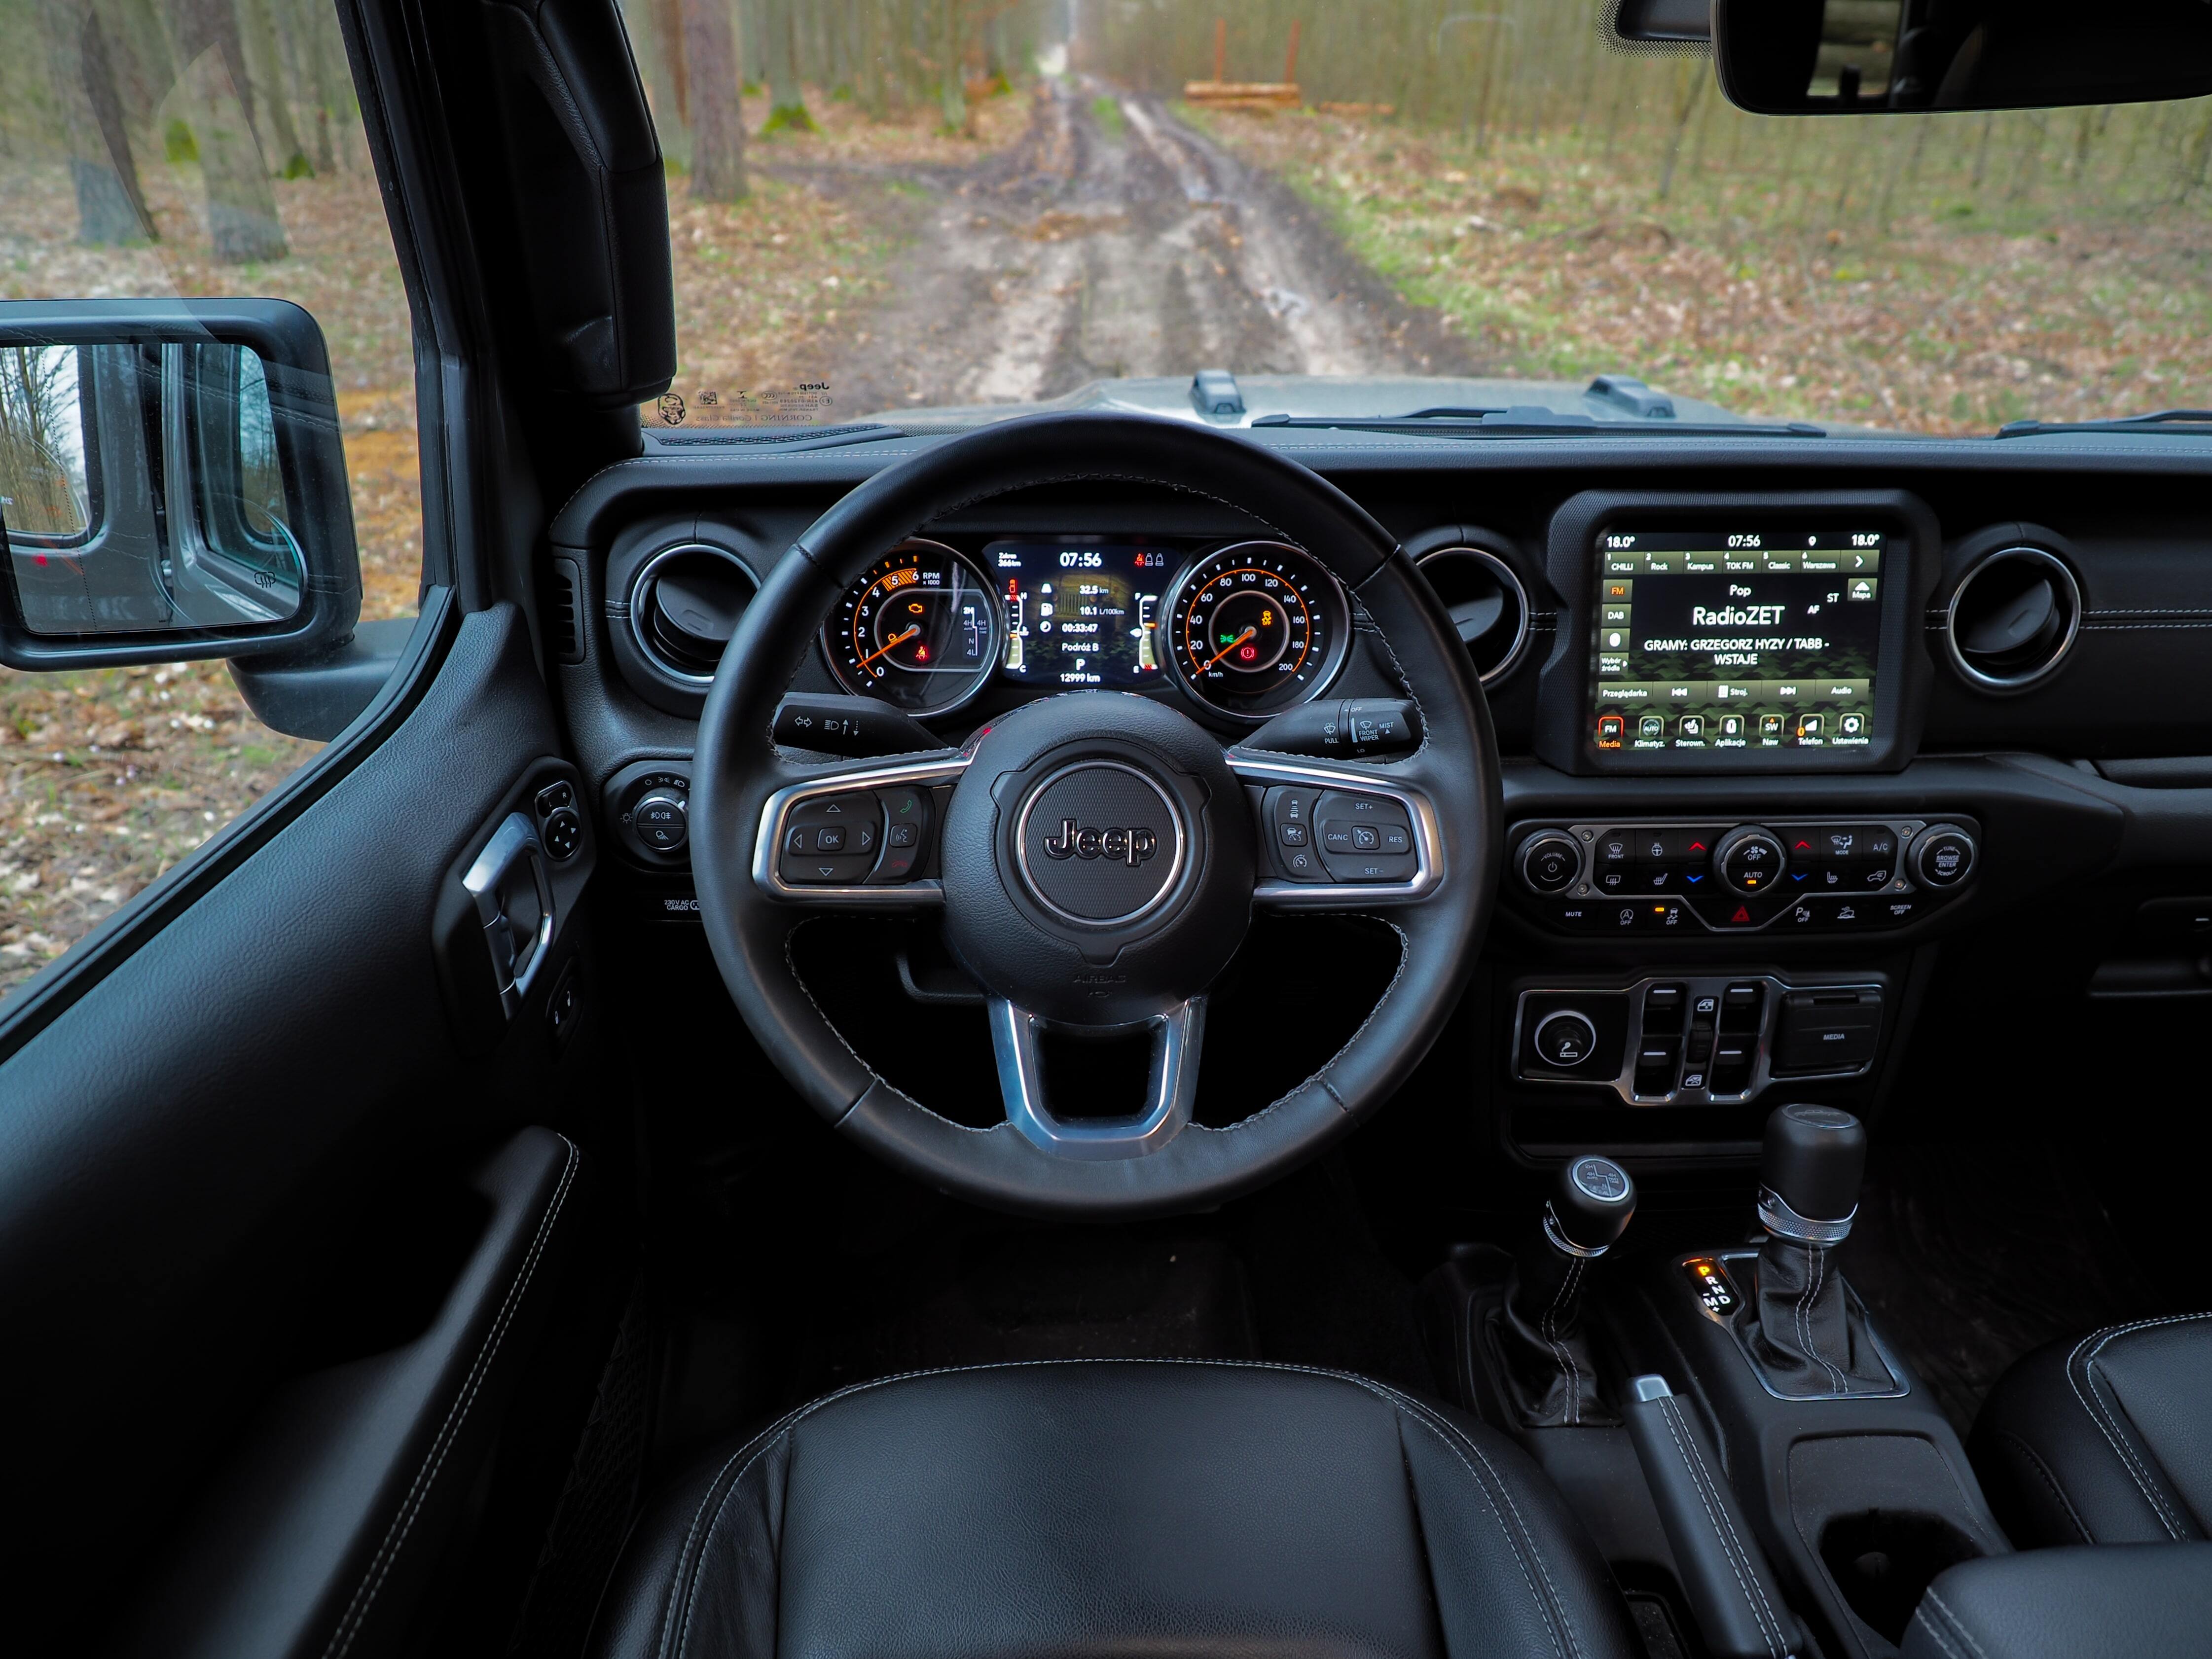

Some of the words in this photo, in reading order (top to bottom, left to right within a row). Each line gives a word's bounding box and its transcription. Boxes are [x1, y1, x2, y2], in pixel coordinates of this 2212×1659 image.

[1728, 535, 1761, 547] 07:56
[1060, 552, 1102, 567] 07:56
[1687, 562, 1714, 571] Kampus
[912, 571, 919, 580] 6
[891, 576, 899, 585] 5
[1220, 578, 1232, 586] 80
[1265, 579, 1278, 587] 120
[872, 588, 880, 598] 4
[1080, 585, 1098, 594] 32.5
[1730, 584, 1751, 597] Pop
[1200, 593, 1213, 602] 60
[1284, 595, 1296, 603] 140
[1827, 593, 1839, 603] ST
[1852, 591, 1871, 599] Mapa
[862, 607, 869, 616] 3
[1080, 607, 1097, 615] 10.1
[1807, 605, 1820, 614] AF
[1190, 615, 1202, 624] 40
[1293, 615, 1305, 624] 160
[1693, 605, 1785, 625] RadioZET
[858, 627, 865, 637] 2
[1062, 623, 1098, 632] 00:33:47
[1062, 643, 1091, 652] Podróż
[1092, 643, 1099, 651] B
[1190, 641, 1203, 649] 20
[1644, 640, 1688, 651] GRAMY:
[1690, 639, 1754, 650] GRZEGORZ
[1794, 638, 1823, 649] TABB
[1714, 653, 1758, 665] WSTAJE
[1076, 658, 1085, 670] P
[1203, 660, 1211, 671] 0
[876, 667, 885, 677] 0
[1060, 674, 1086, 683] 12999
[1087, 674, 1100, 683] km
[1602, 689, 1648, 698] Przeglądarka
[1730, 688, 1748, 697] Stroj.
[1831, 686, 1852, 695] Audio
[1604, 724, 1617, 733] FM
[1765, 722, 1779, 731] SW
[1634, 739, 1666, 749] Klimatyz.
[1675, 739, 1705, 748] Sterown.
[1714, 738, 1746, 748] Aplikacje
[1798, 737, 1823, 746] Telefon
[1832, 737, 1869, 745] Ustawienia
[825, 834, 839, 844] OK
[1044, 819, 1157, 866] Jeep
[1873, 843, 1888, 852] A/C
[1796, 907, 1803, 916] P
[1698, 1266, 1710, 1276] P
[1705, 1276, 1718, 1285] R
[1711, 1285, 1726, 1295] N
[1703, 1297, 1719, 1307] M
[1718, 1295, 1731, 1304] D
